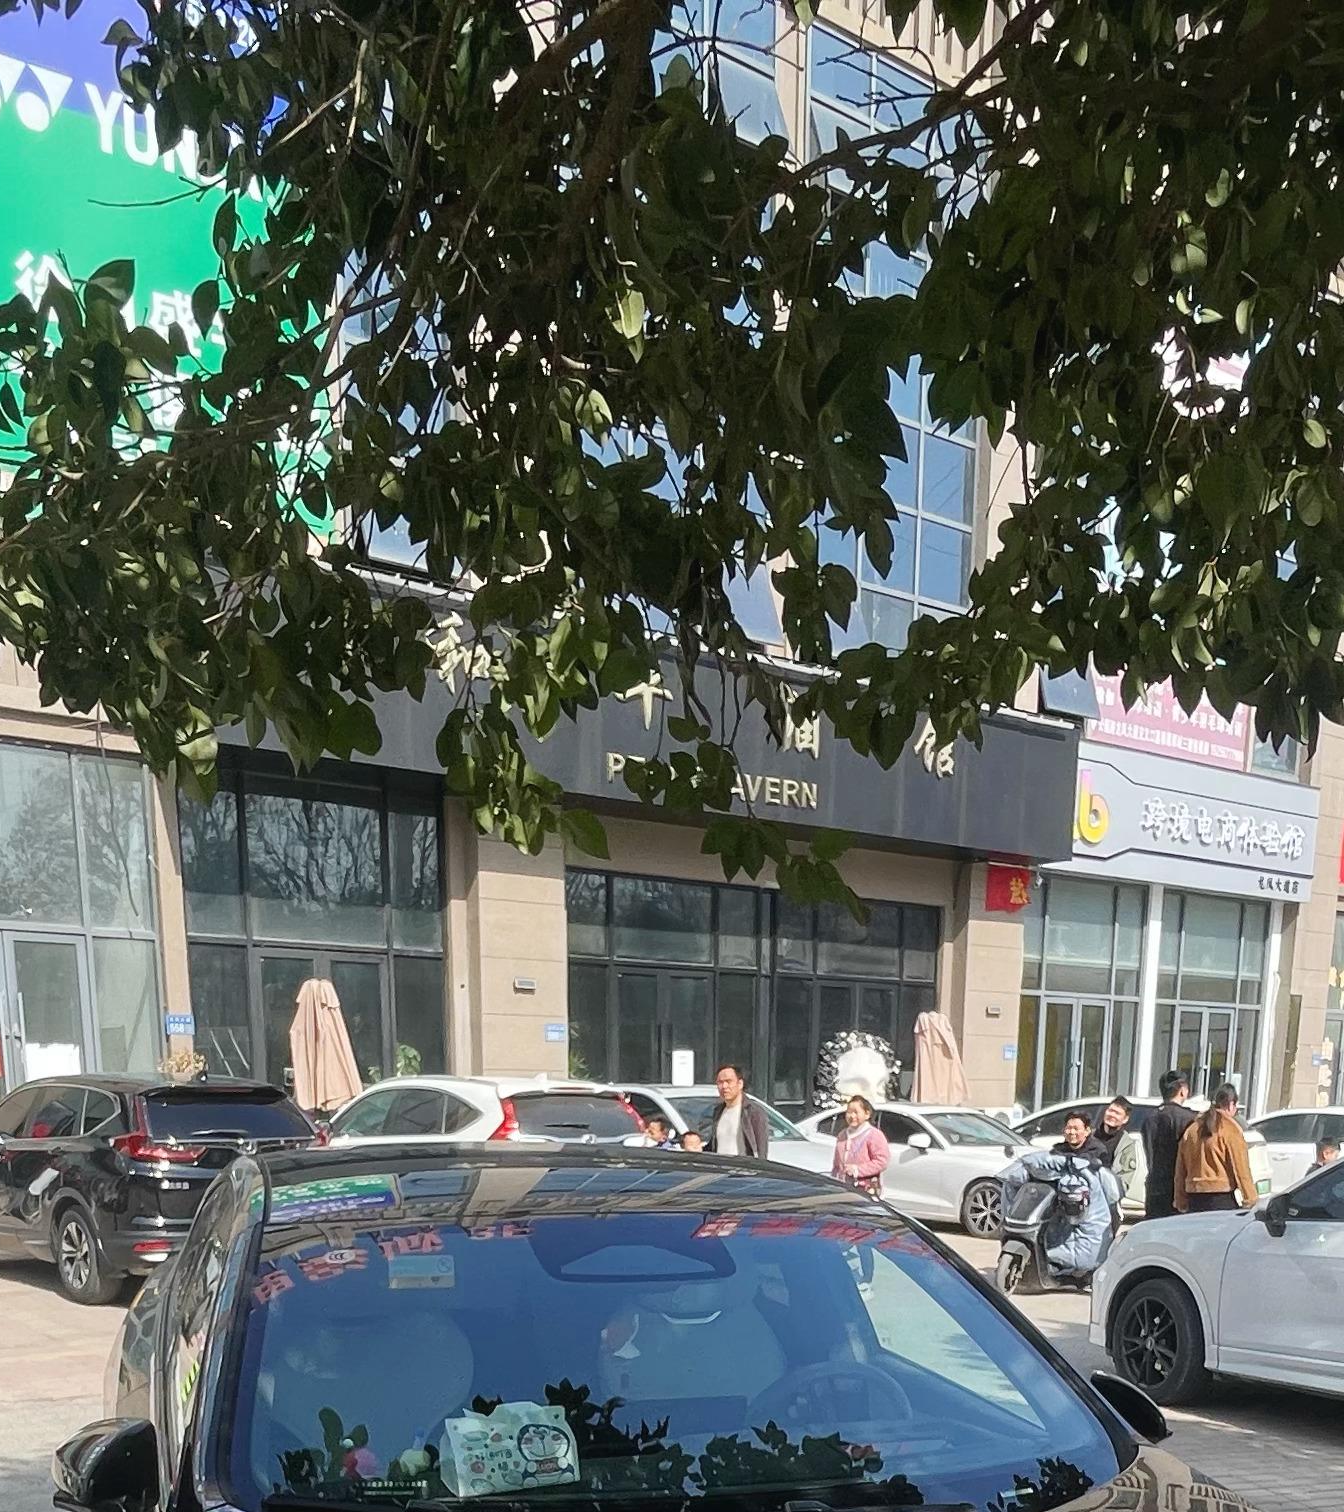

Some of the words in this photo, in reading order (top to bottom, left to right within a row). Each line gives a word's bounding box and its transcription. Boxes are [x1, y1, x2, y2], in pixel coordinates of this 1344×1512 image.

[733, 772, 824, 811] AVERN
[1139, 797, 1306, 860] 跨境电商体验馆
